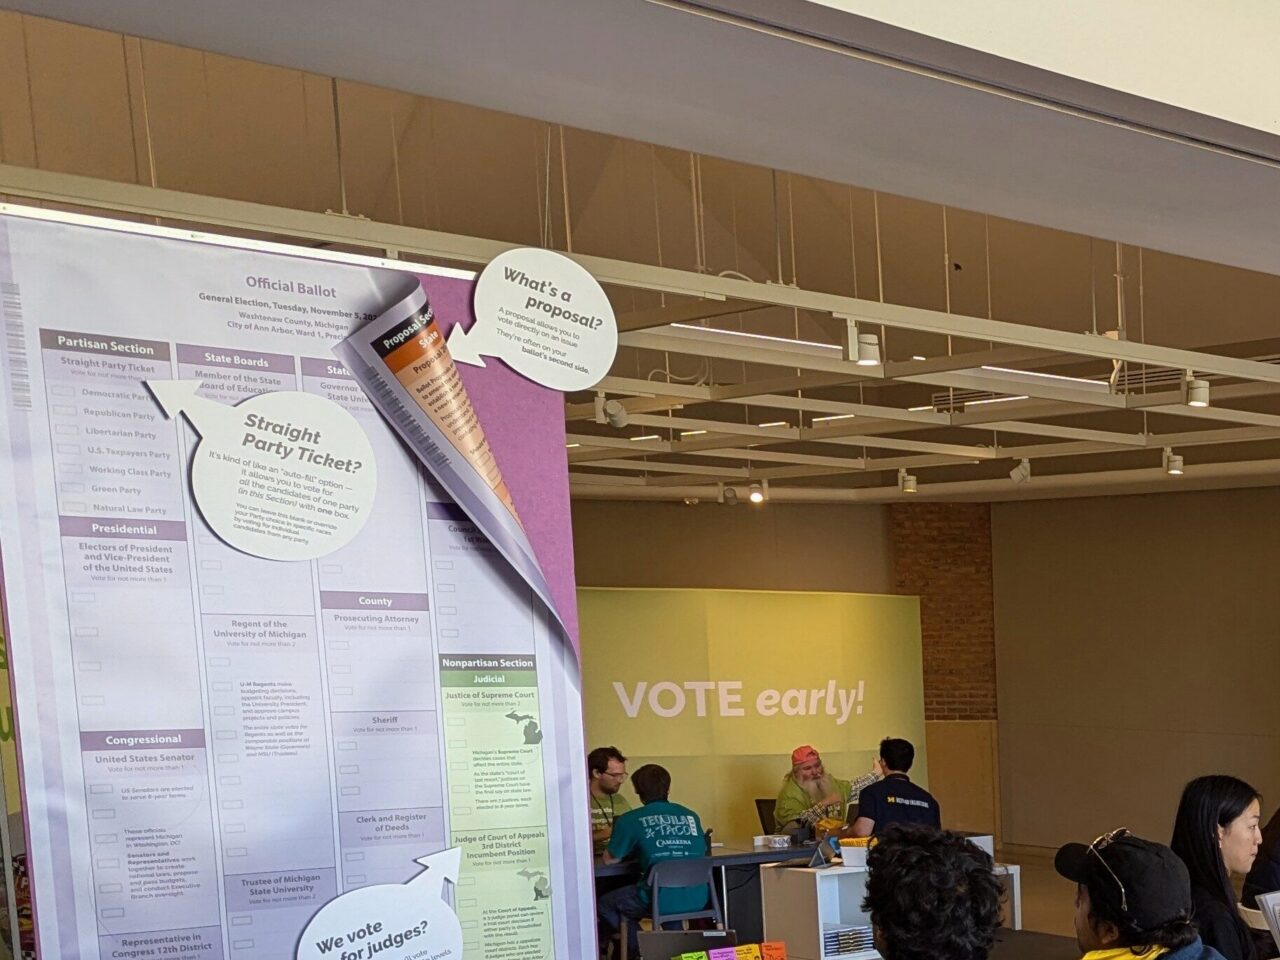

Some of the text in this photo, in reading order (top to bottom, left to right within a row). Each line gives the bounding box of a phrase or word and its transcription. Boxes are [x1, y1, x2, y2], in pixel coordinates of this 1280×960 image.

[246, 275, 337, 299] Official Ballot
[504, 265, 572, 303] What's a
[198, 292, 377, 321] General Election, Tuesday, November 5, 202
[525, 296, 603, 330] proposal?
[238, 311, 349, 331] Washtenaw County, Michigan
[505, 308, 536, 324] proposal
[536, 320, 558, 333] allows
[559, 328, 572, 339] you
[573, 332, 580, 340] to
[382, 320, 421, 350] Proposal
[418, 331, 439, 349] State
[497, 316, 578, 348] vote directly on an issue
[57, 335, 155, 355] Partisan Section
[496, 327, 567, 358] They're often on your
[60, 356, 155, 374] Straight Party Ticket
[204, 352, 269, 368] State Boards
[521, 346, 589, 374] ballot's second side.
[244, 413, 322, 445] Straight
[242, 432, 363, 474] Party Ticket?
[209, 451, 221, 460] It's
[222, 454, 240, 465] kind
[252, 461, 267, 471] like
[318, 478, 344, 491] option
[248, 470, 275, 483] allows
[277, 477, 292, 487] you
[293, 480, 301, 488] to
[303, 483, 321, 494] vote
[322, 486, 333, 496] for
[238, 488, 351, 520] (in this Section) with one box.
[251, 480, 266, 490] the
[266, 484, 311, 501] candidates
[322, 499, 337, 507] one
[338, 502, 360, 514] party
[92, 523, 157, 535] Presidential
[78, 542, 117, 552] Electors
[130, 544, 172, 553] President
[84, 553, 170, 563] and Vice-President
[94, 564, 110, 572] the
[358, 596, 393, 608] County
[442, 659, 533, 668] Nonpartisan Section
[474, 675, 505, 683] Judicial
[612, 679, 865, 725] VOTE early!
[372, 716, 398, 724] Sheriff
[106, 734, 182, 746] Congressional
[95, 755, 127, 763] United
[394, 813, 427, 823] Register
[638, 814, 689, 827] TEQUILA
[517, 832, 545, 841] Appeals
[655, 825, 691, 836] TACO
[467, 851, 505, 859] Incumbent
[241, 878, 272, 886] Trustee
[284, 874, 320, 883] Michigan
[249, 884, 314, 895] State University
[121, 934, 191, 948] Representative
[316, 921, 383, 954] We vote
[366, 920, 428, 959] judges?
[111, 948, 155, 958] Congress
[180, 943, 212, 951] District
[412, 950, 428, 958] vote
[431, 949, 452, 960] levels
